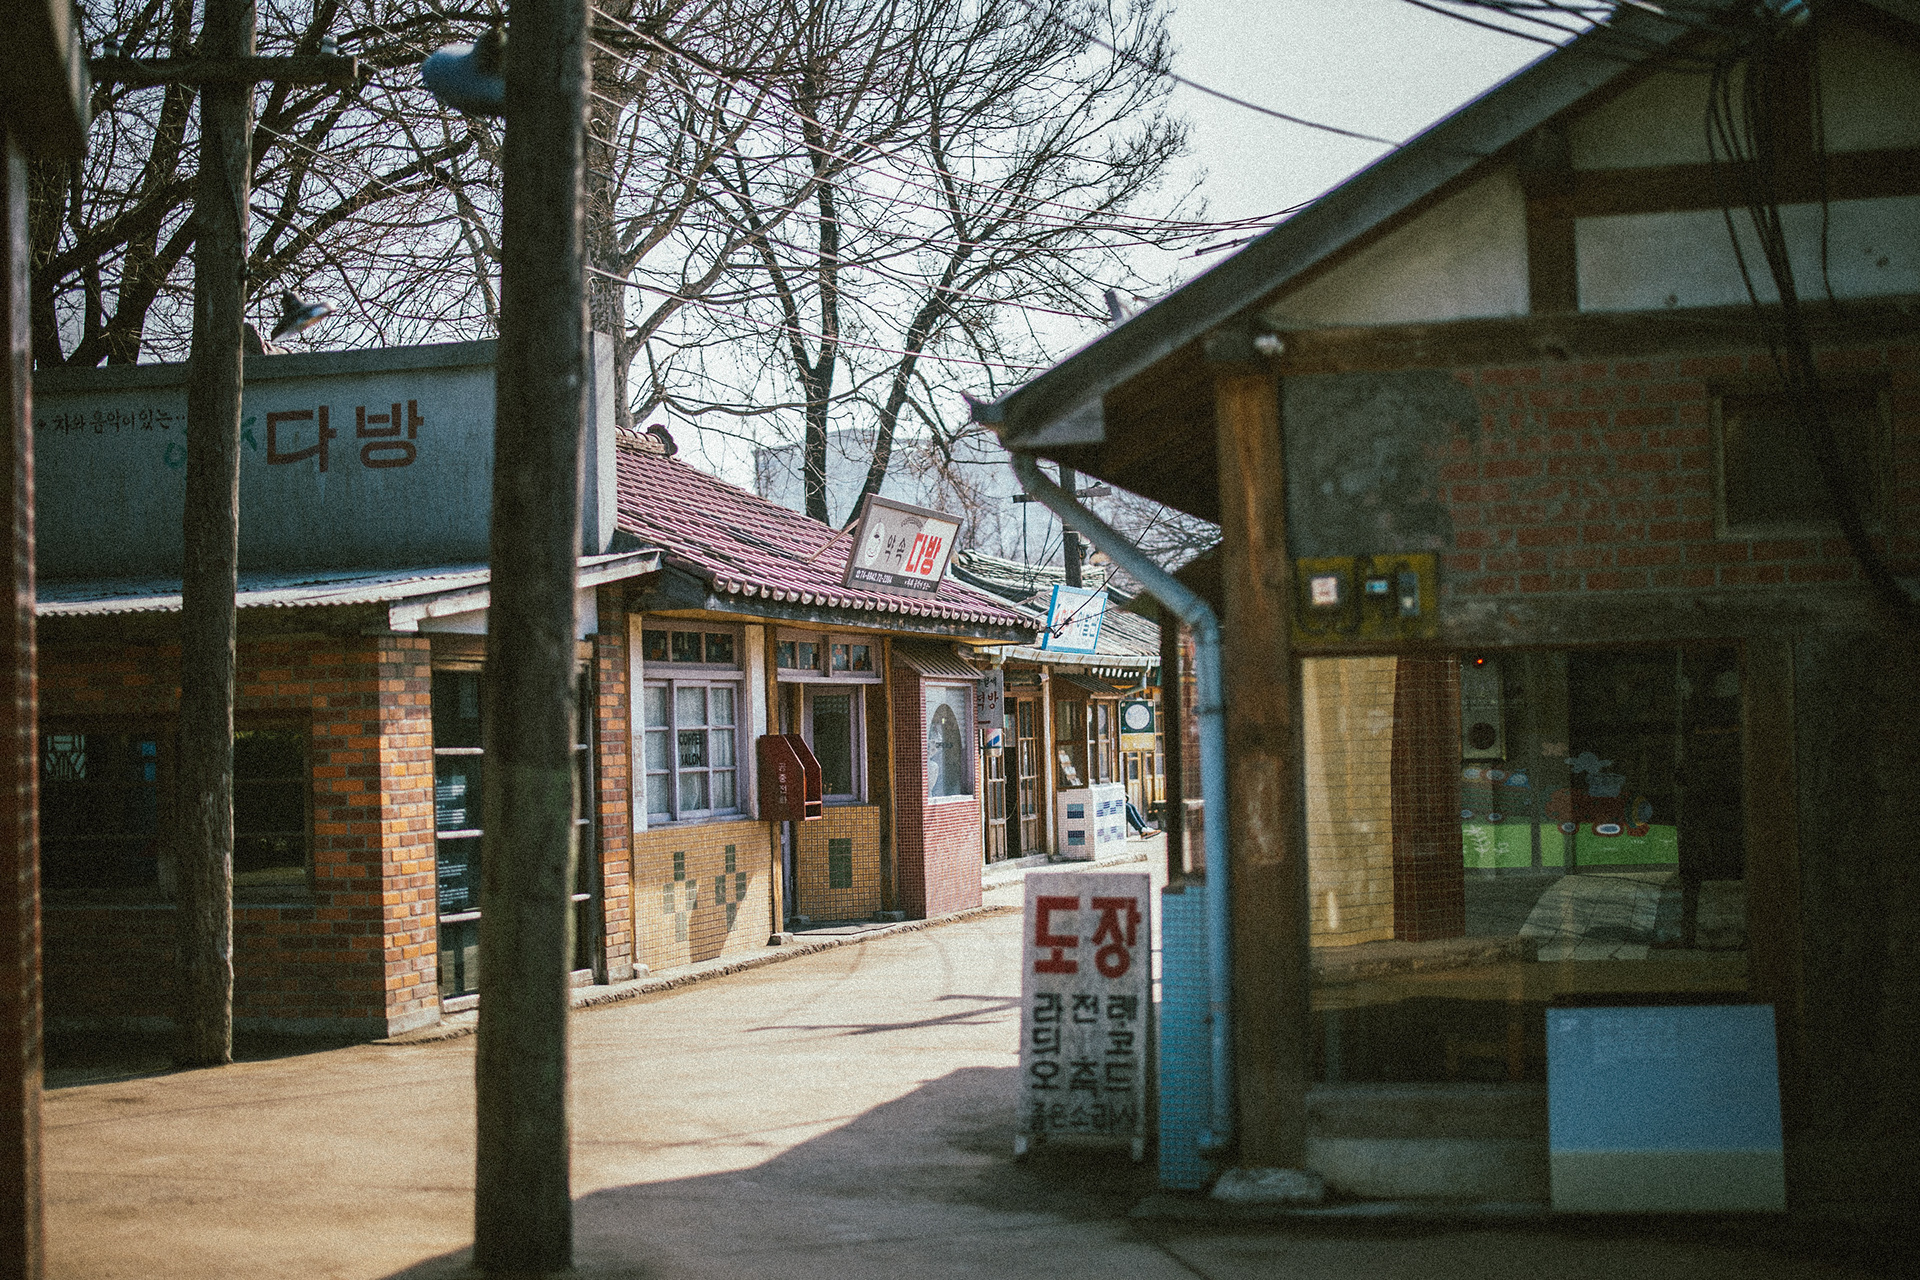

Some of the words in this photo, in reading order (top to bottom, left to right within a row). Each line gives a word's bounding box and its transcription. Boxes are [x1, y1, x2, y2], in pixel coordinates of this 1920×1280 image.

[53, 412, 86, 435] 차와
[89, 409, 136, 434] 음악이
[266, 399, 425, 473] 다방
[884, 534, 907, 566] 약속
[905, 533, 942, 575] 다방
[679, 733, 703, 746] COFFEE
[681, 753, 702, 767] SALON
[1033, 894, 1142, 979] 도장
[1031, 993, 1063, 1091] 라디오
[1070, 994, 1100, 1098] 전축
